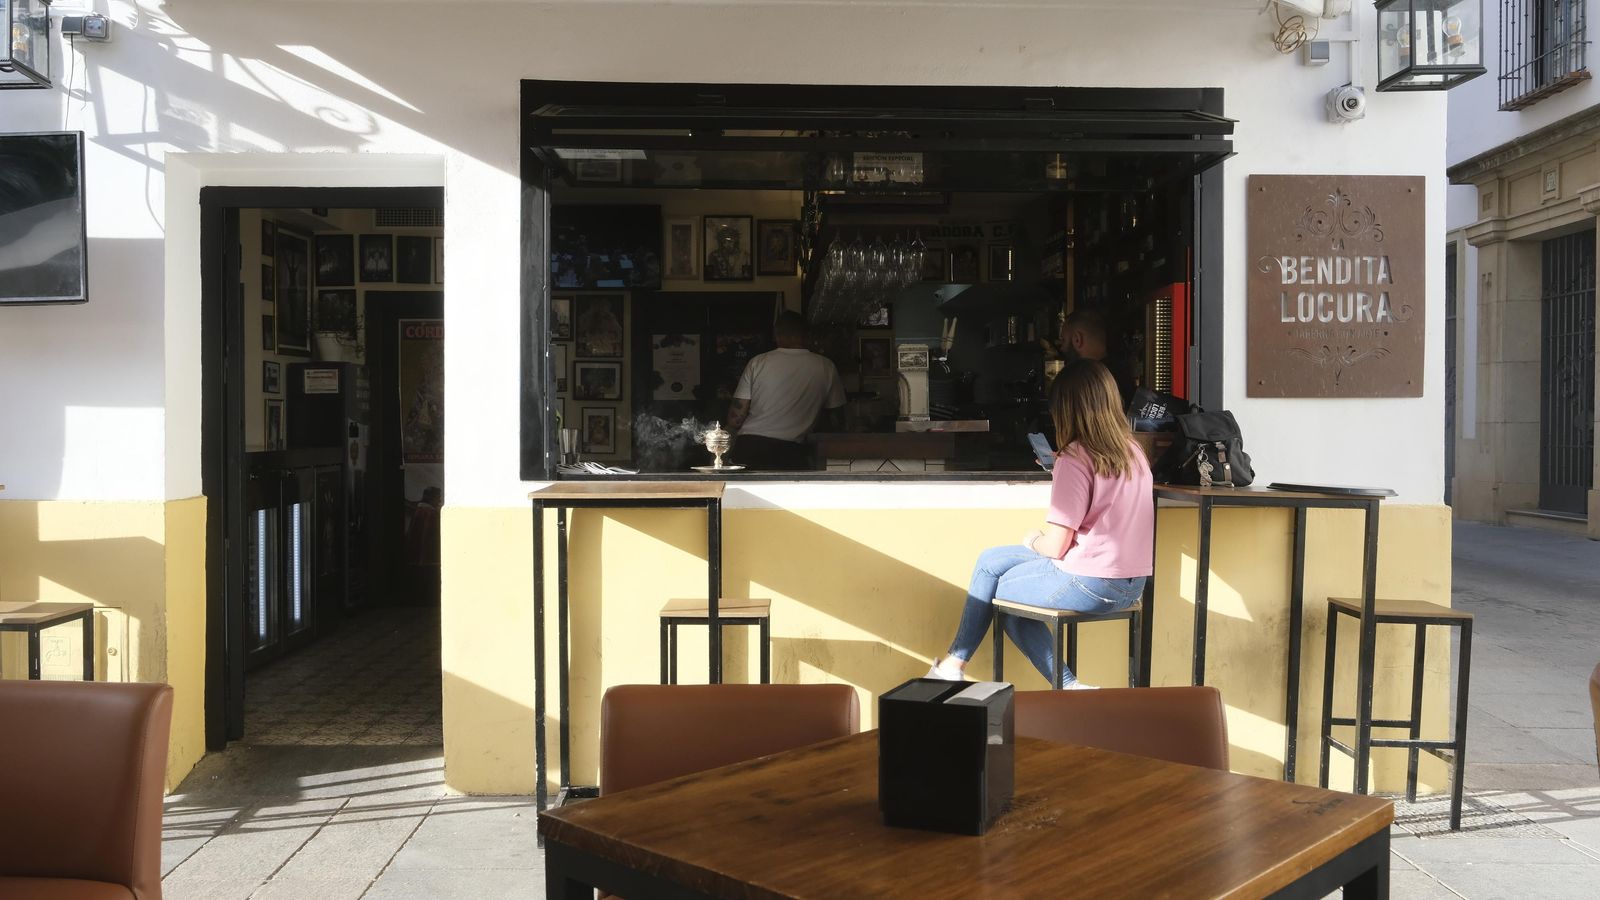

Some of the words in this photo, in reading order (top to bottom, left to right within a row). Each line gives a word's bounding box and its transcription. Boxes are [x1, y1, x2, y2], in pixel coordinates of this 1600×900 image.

[1331, 238, 1345, 251] LA
[1281, 255, 1393, 285] BENDITA
[1281, 291, 1393, 323] LOCURA
[407, 322, 443, 338] CÓRD
[1149, 403, 1160, 419] LOCU
